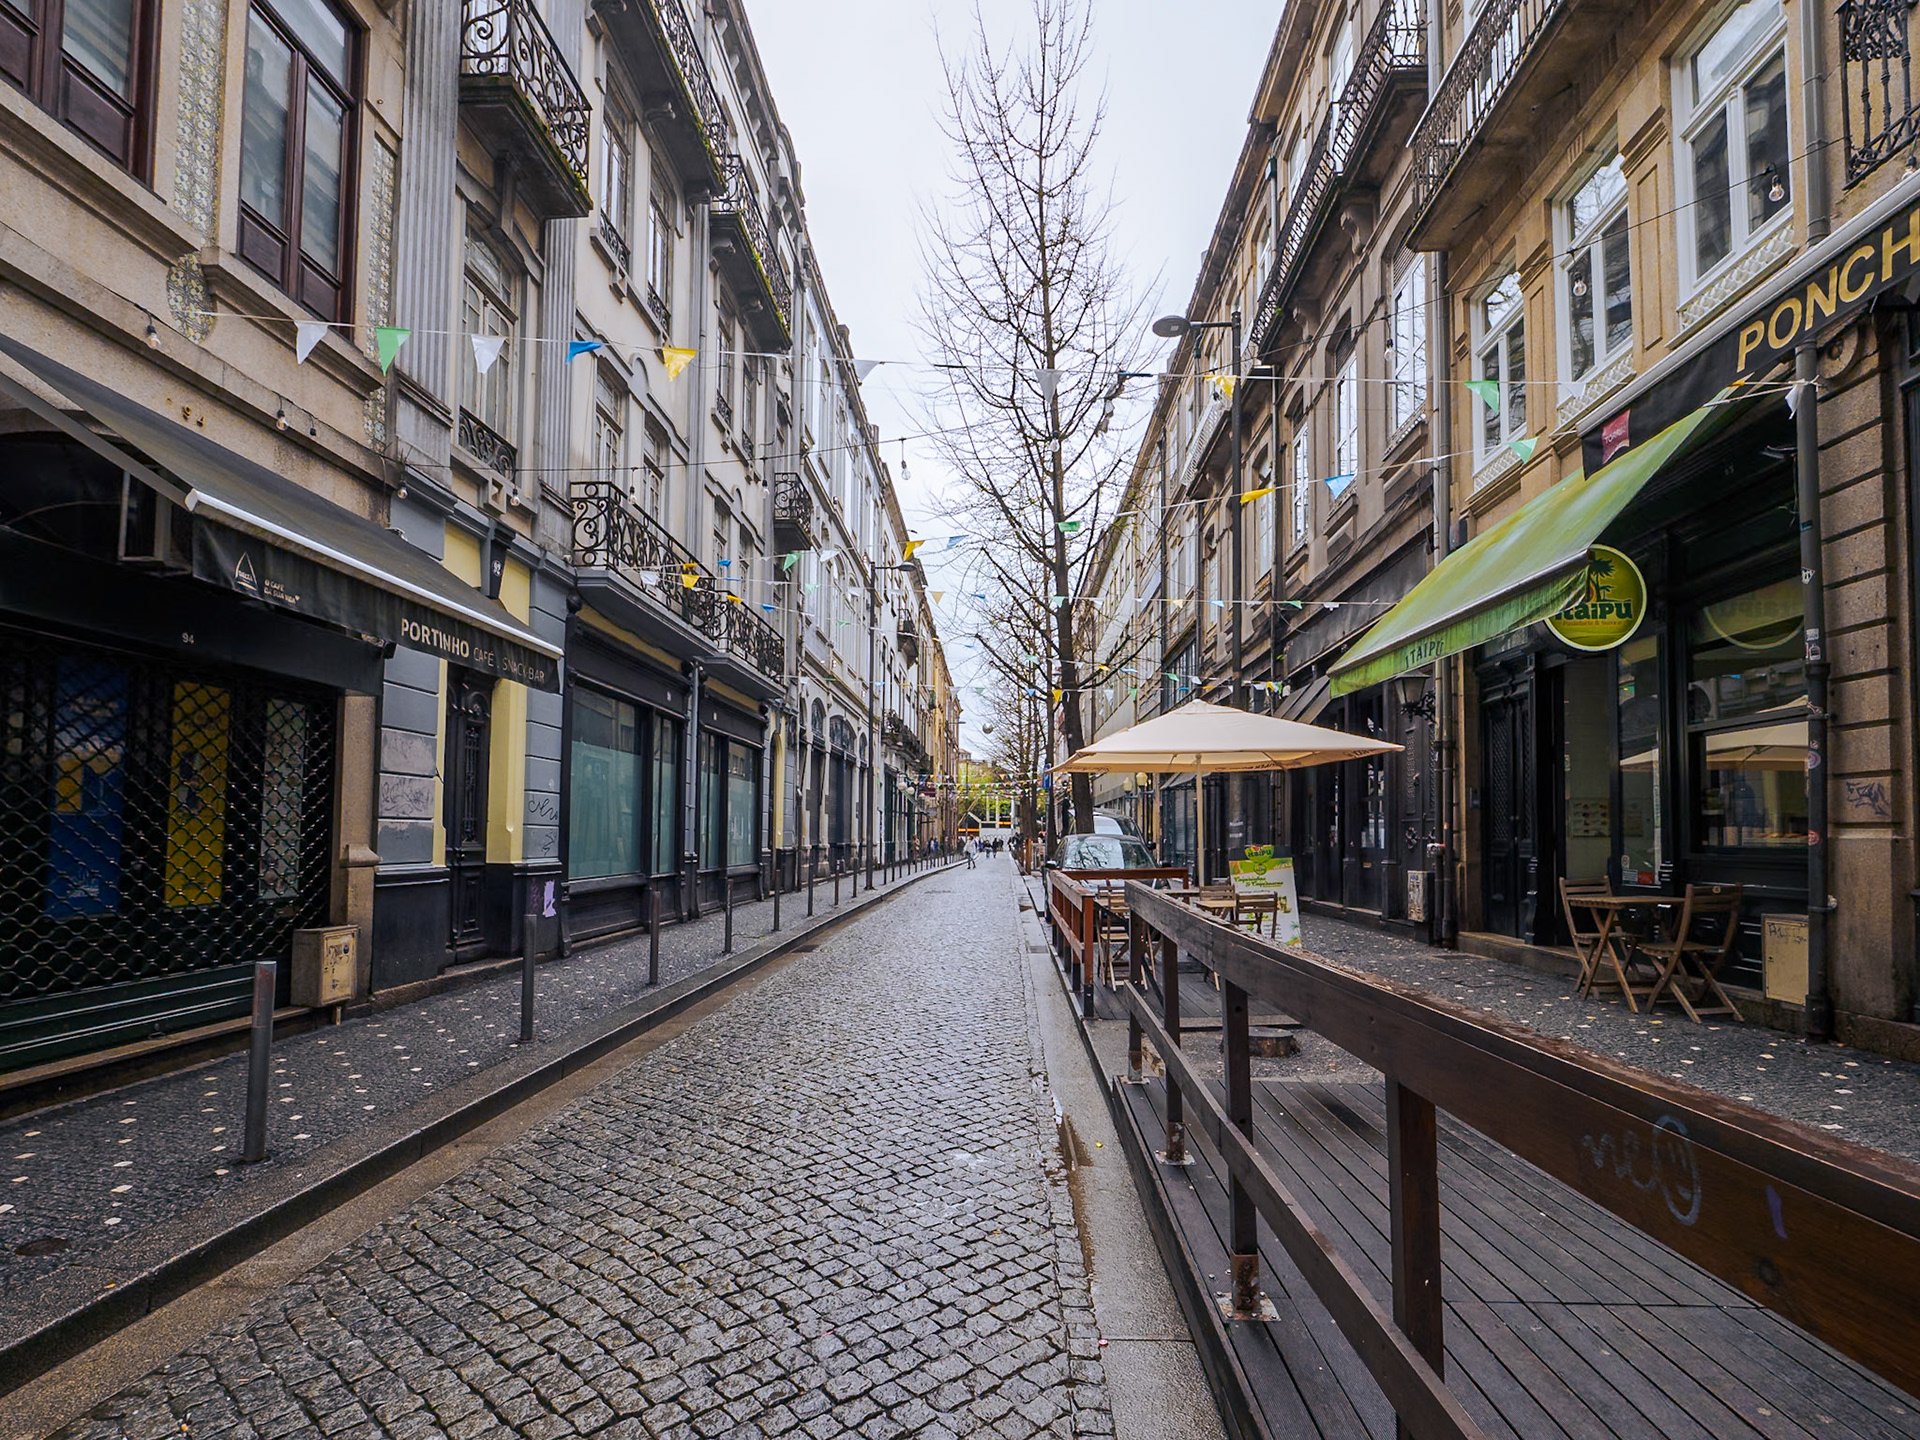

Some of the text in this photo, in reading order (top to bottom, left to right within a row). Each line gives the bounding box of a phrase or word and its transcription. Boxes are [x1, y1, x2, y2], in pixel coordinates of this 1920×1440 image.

[1736, 208, 1920, 373] PONCH
[401, 617, 470, 658] PORTINHO
[473, 647, 494, 668] CAFÉ
